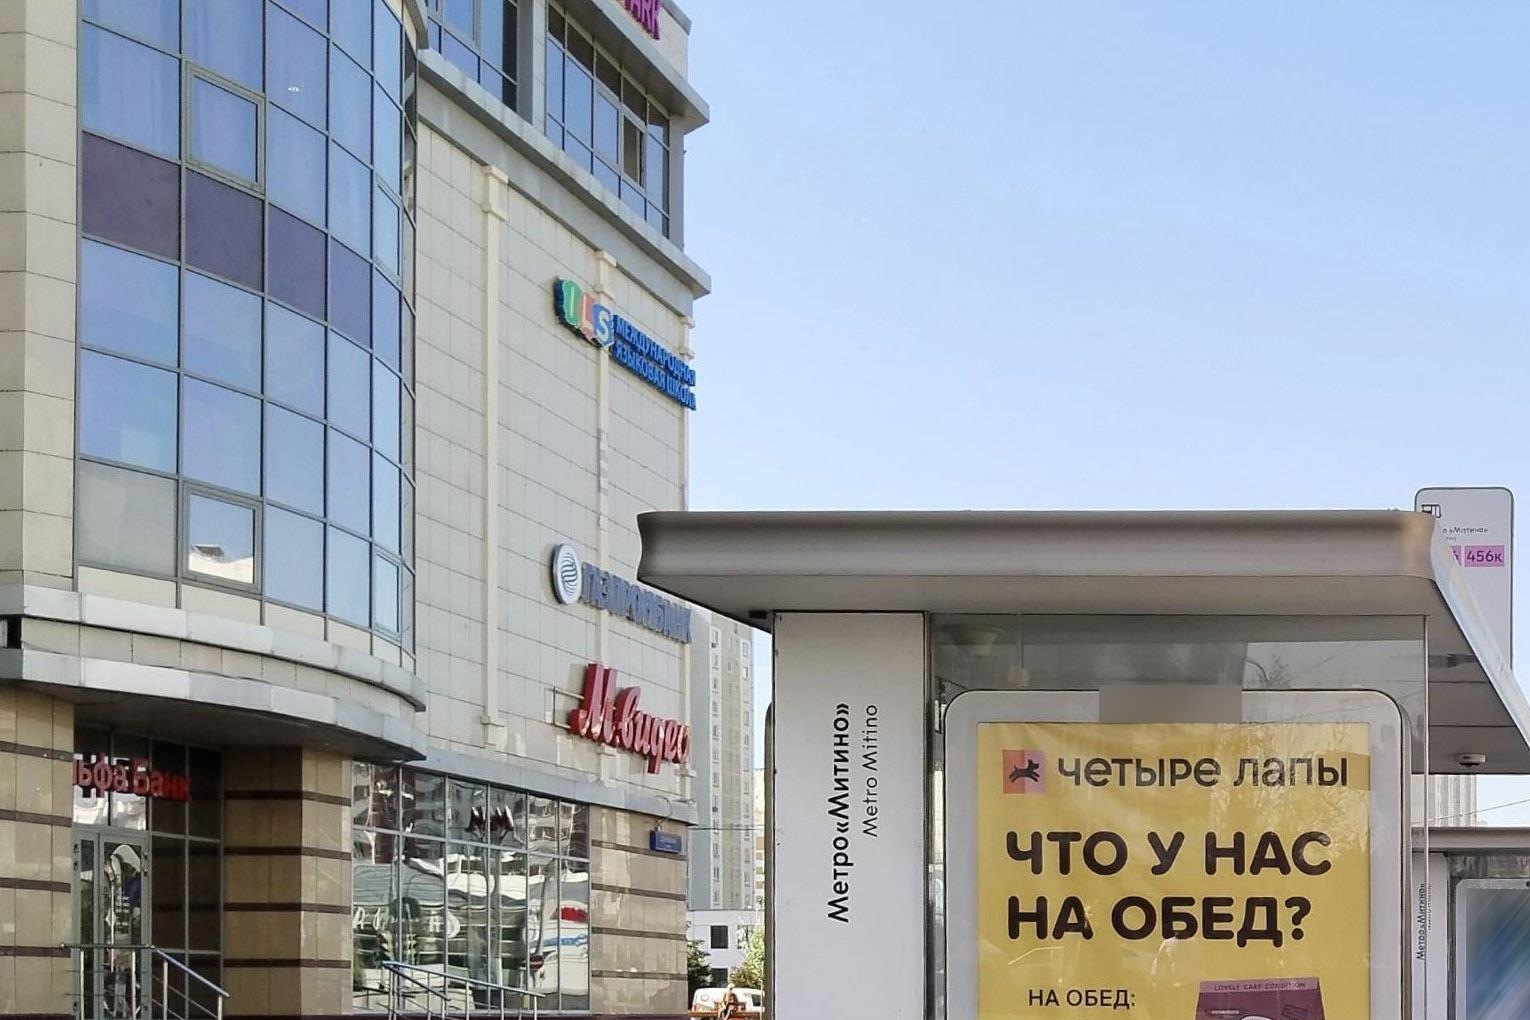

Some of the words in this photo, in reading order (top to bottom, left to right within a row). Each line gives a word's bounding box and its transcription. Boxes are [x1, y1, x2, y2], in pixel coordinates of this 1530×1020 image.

[862, 704, 878, 771] Mitino
[862, 777, 878, 838] Metro
[1006, 831, 1128, 876] ЧТО
[1147, 831, 1185, 876] У
[1205, 831, 1332, 876] НАС
[1008, 896, 1094, 940] НА
[1111, 896, 1312, 948] ОБЕД?
[1028, 990, 1061, 1006] НА
[1066, 990, 1136, 1009] ОБЕД:
